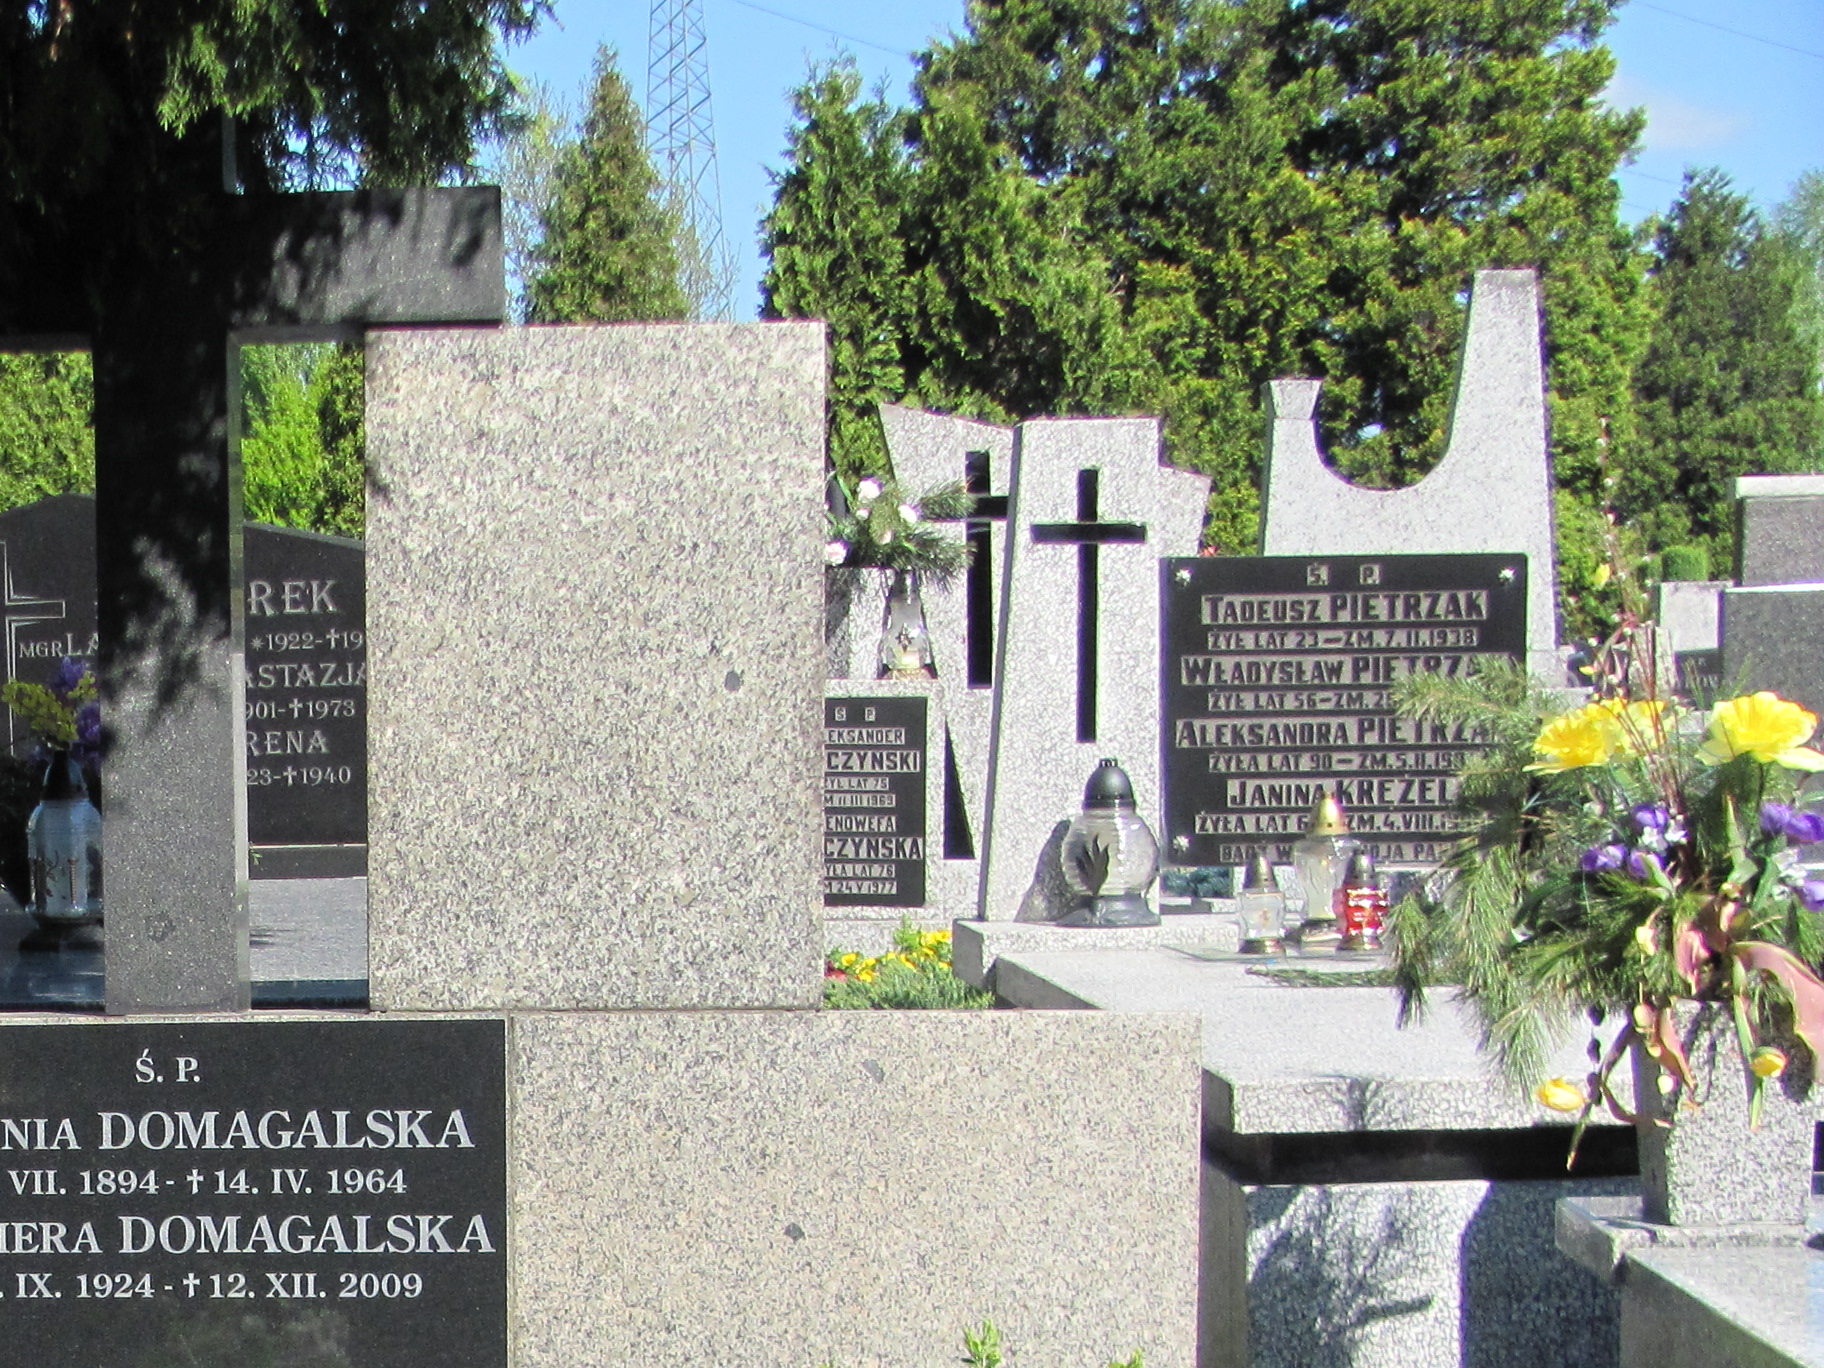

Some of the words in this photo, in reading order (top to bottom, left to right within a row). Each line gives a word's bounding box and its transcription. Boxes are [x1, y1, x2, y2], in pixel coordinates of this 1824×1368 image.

[1204, 595, 1321, 623] TADEUSZ
[1329, 590, 1487, 621] PIETRZAK
[1255, 631, 1287, 648] LAT
[1181, 657, 1344, 685] WŁADYSŁAW
[1254, 692, 1286, 709] LAT
[1178, 719, 1348, 747] ALEKSANDRA
[1268, 753, 1300, 769] LAT
[1255, 815, 1289, 832] LAT
[135, 1048, 164, 1083] Ś.
[176, 1057, 201, 1082] P.
[97, 1110, 475, 1150] DOMAGALSKA
[8, 1170, 67, 1196] VII.
[271, 1169, 313, 1195] IV.
[327, 1168, 407, 1194] 1964
[118, 1213, 497, 1254] DOMAGALSKA
[16, 1272, 62, 1299] IX.
[265, 1272, 327, 1299] XII.
[338, 1272, 423, 1299] 2009
